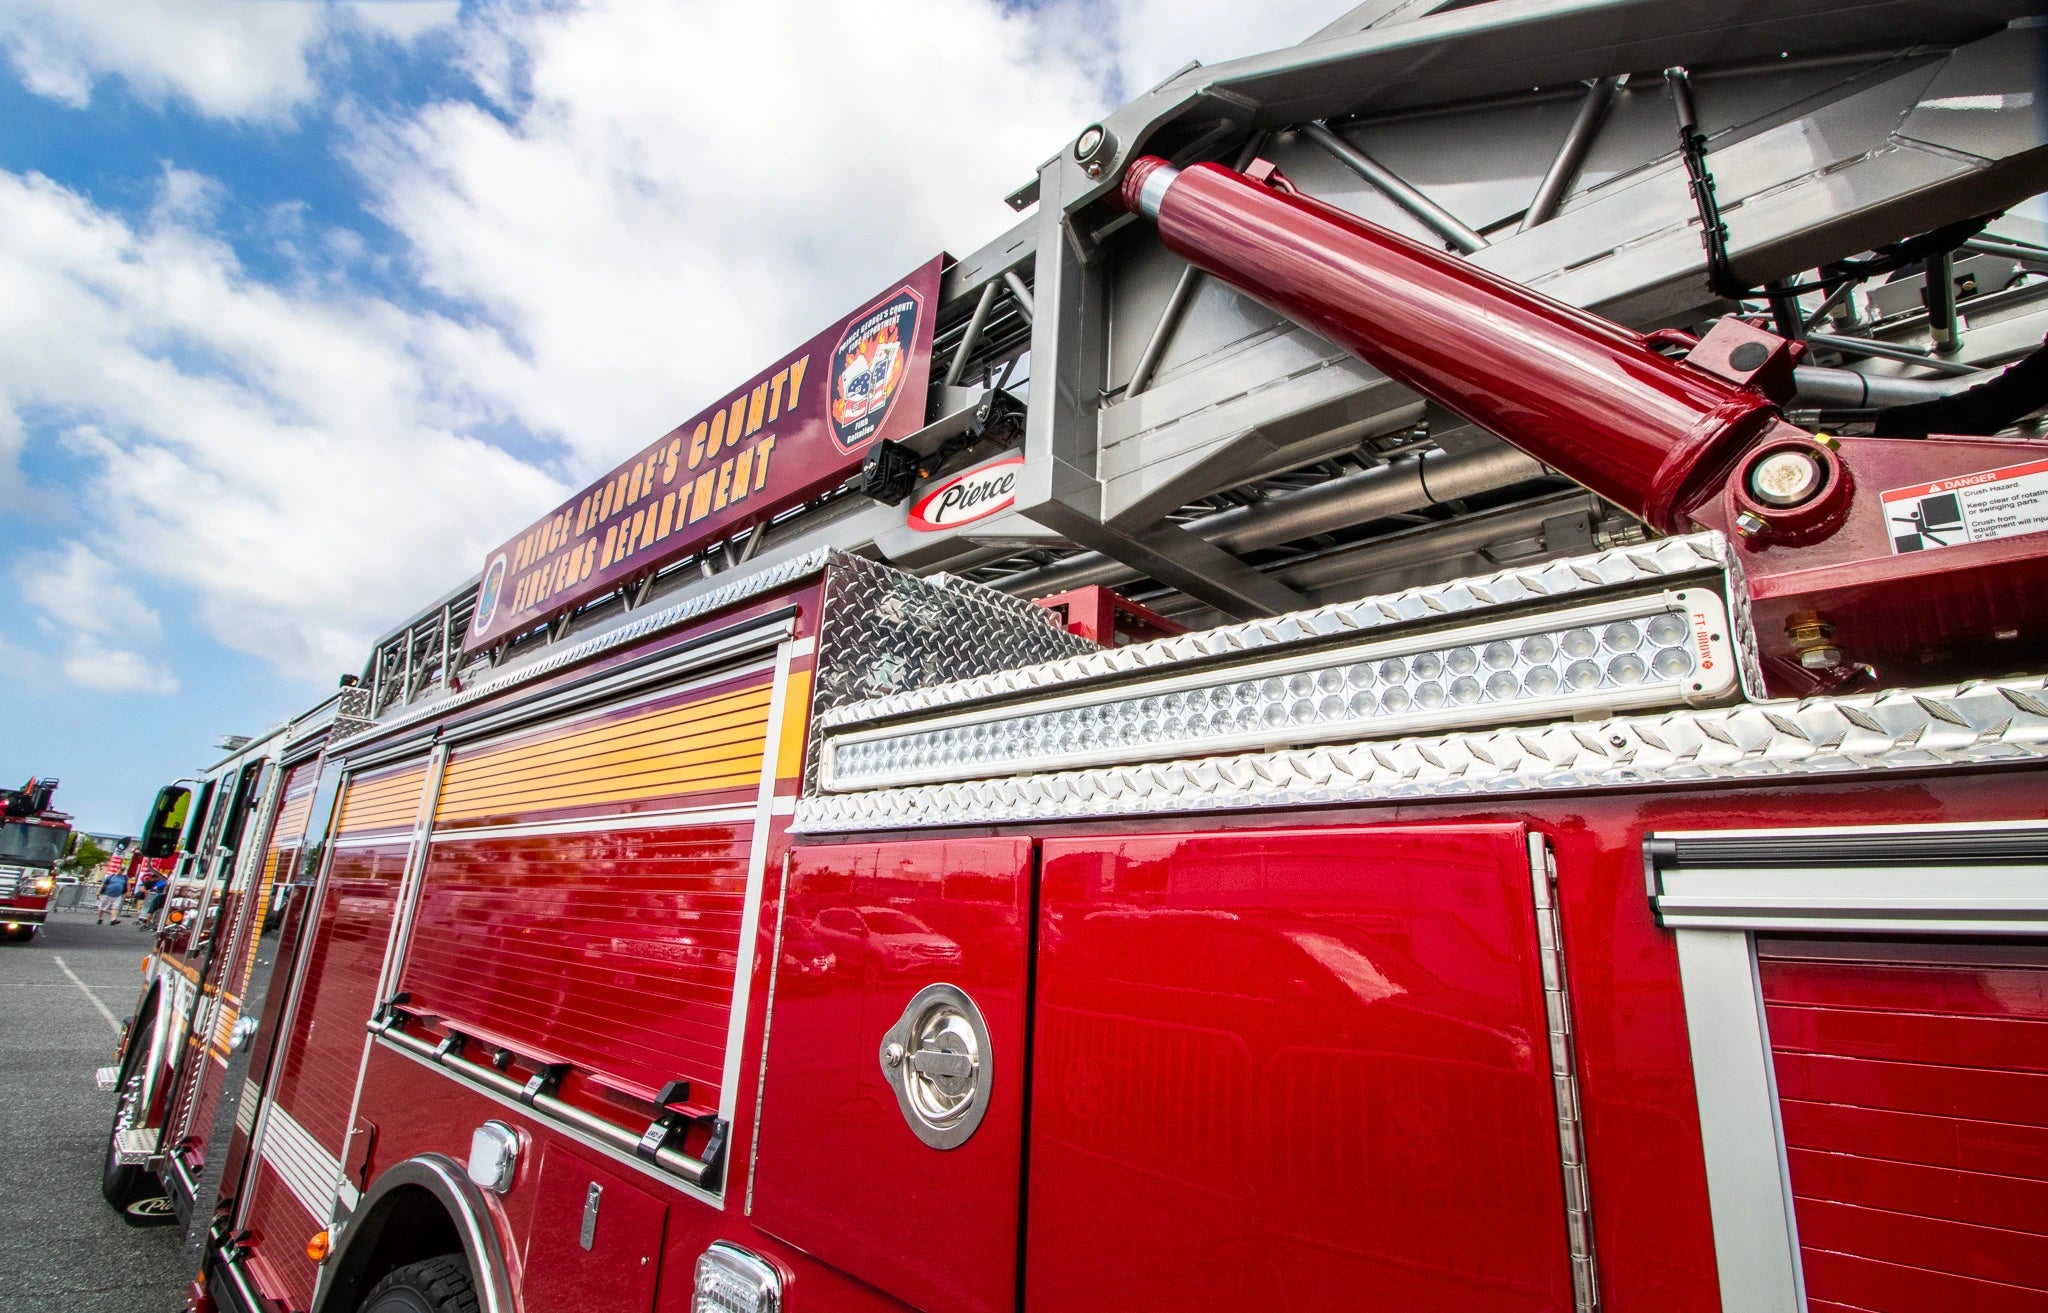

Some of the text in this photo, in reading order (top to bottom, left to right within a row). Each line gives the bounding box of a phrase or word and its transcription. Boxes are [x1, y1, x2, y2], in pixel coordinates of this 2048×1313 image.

[838, 301, 914, 355] PRINCE GEORGE'S COUNTY
[848, 314, 901, 353] FIRE DEPARTMENT
[511, 354, 810, 576] PRINCE GEORGE'S COUNTY
[1943, 472, 1997, 490] DANGER
[935, 472, 1017, 523] Pierce
[1963, 488, 1988, 497] Crush
[1967, 490, 2048, 509] Keep clear of rotatin
[1979, 502, 2015, 513] swinging
[510, 434, 776, 617] FIRE/EMS DEPARTMENT
[1971, 515, 2017, 527] Crush from
[1973, 515, 2048, 534] equipment will inju
